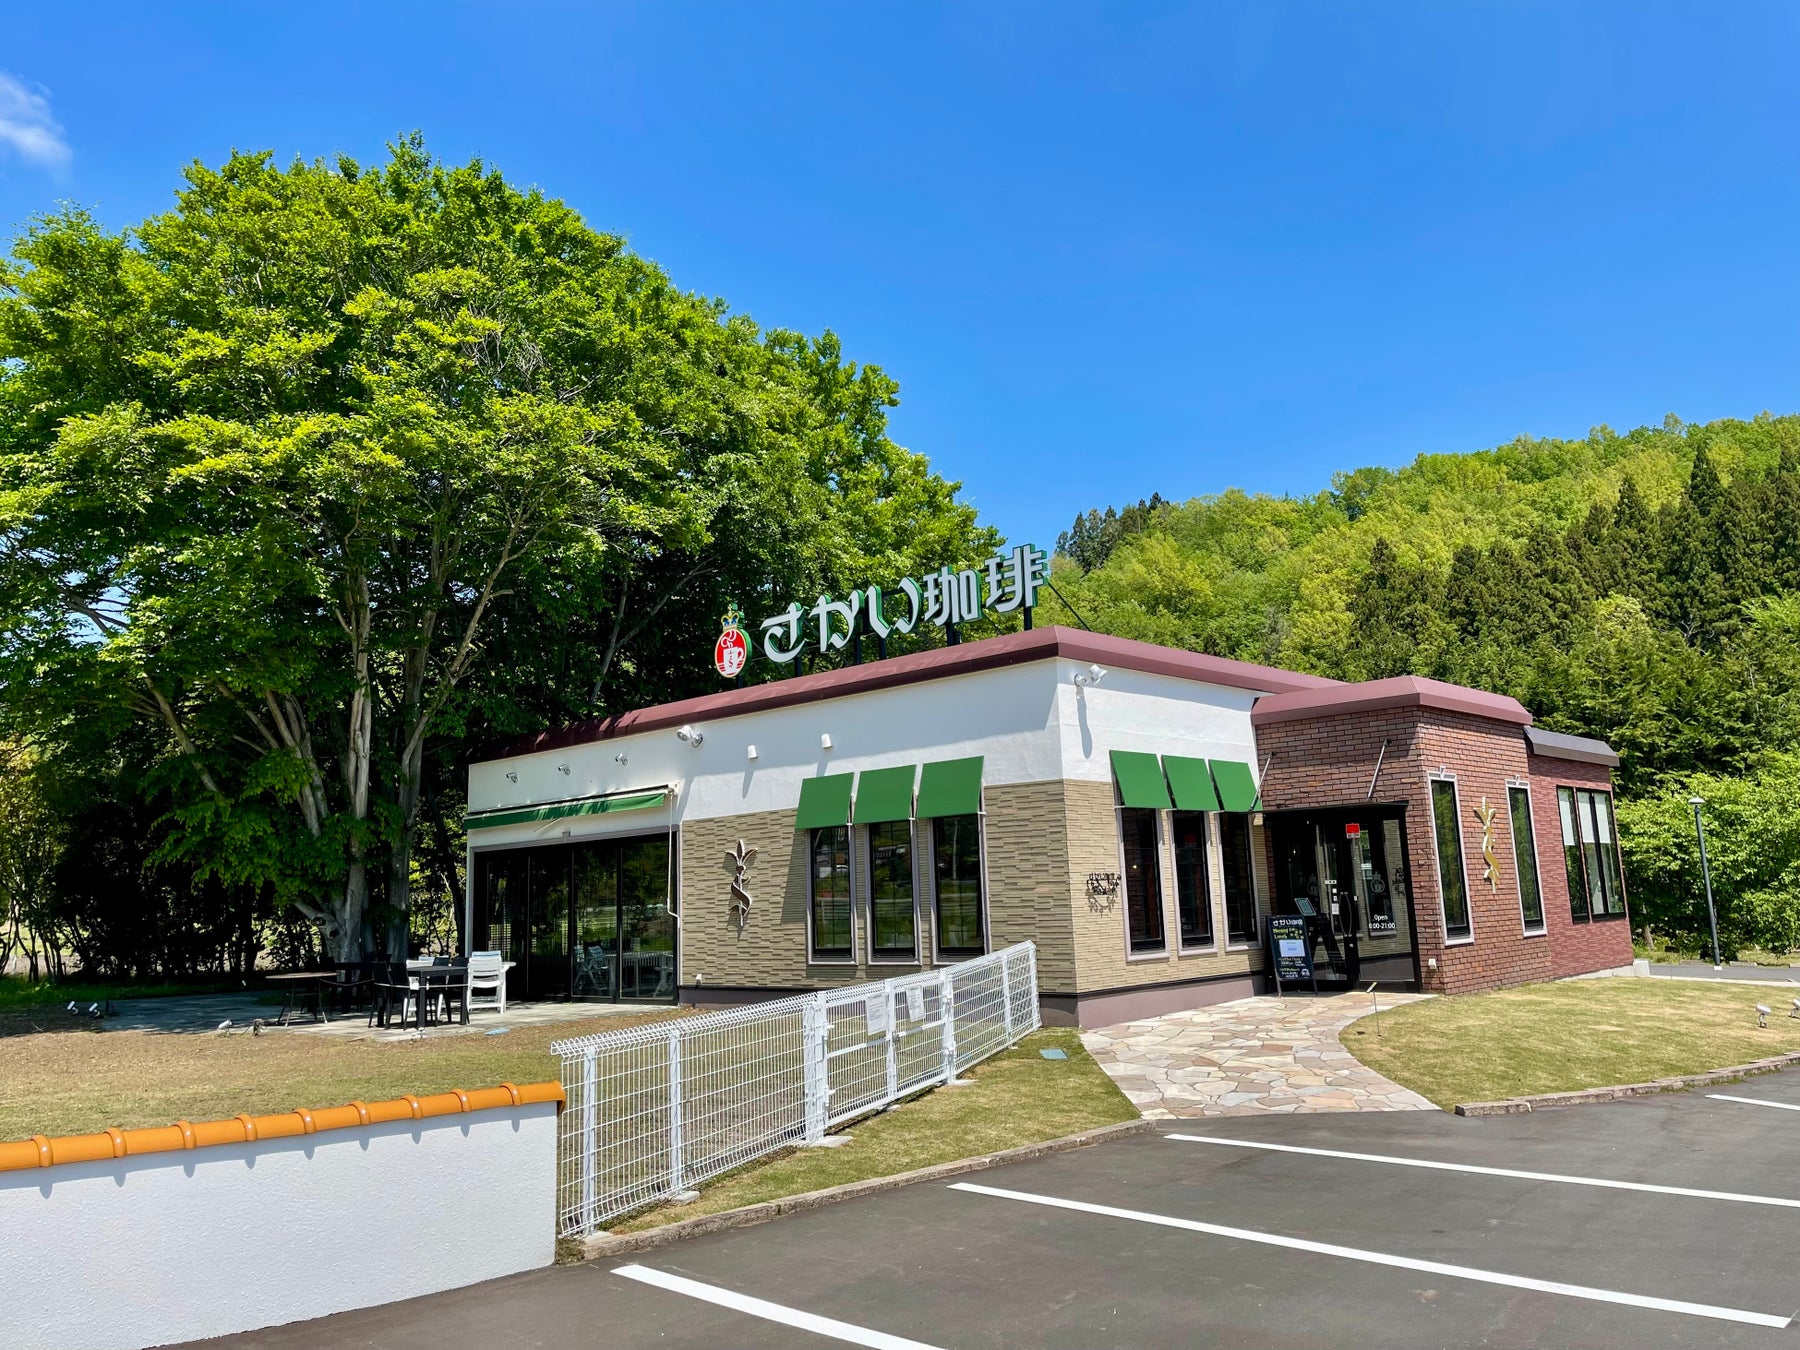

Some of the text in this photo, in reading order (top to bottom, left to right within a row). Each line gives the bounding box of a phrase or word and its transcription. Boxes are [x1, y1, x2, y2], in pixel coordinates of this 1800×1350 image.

[760, 544, 1047, 663] さかい珈琲
[1374, 914, 1389, 922] Open
